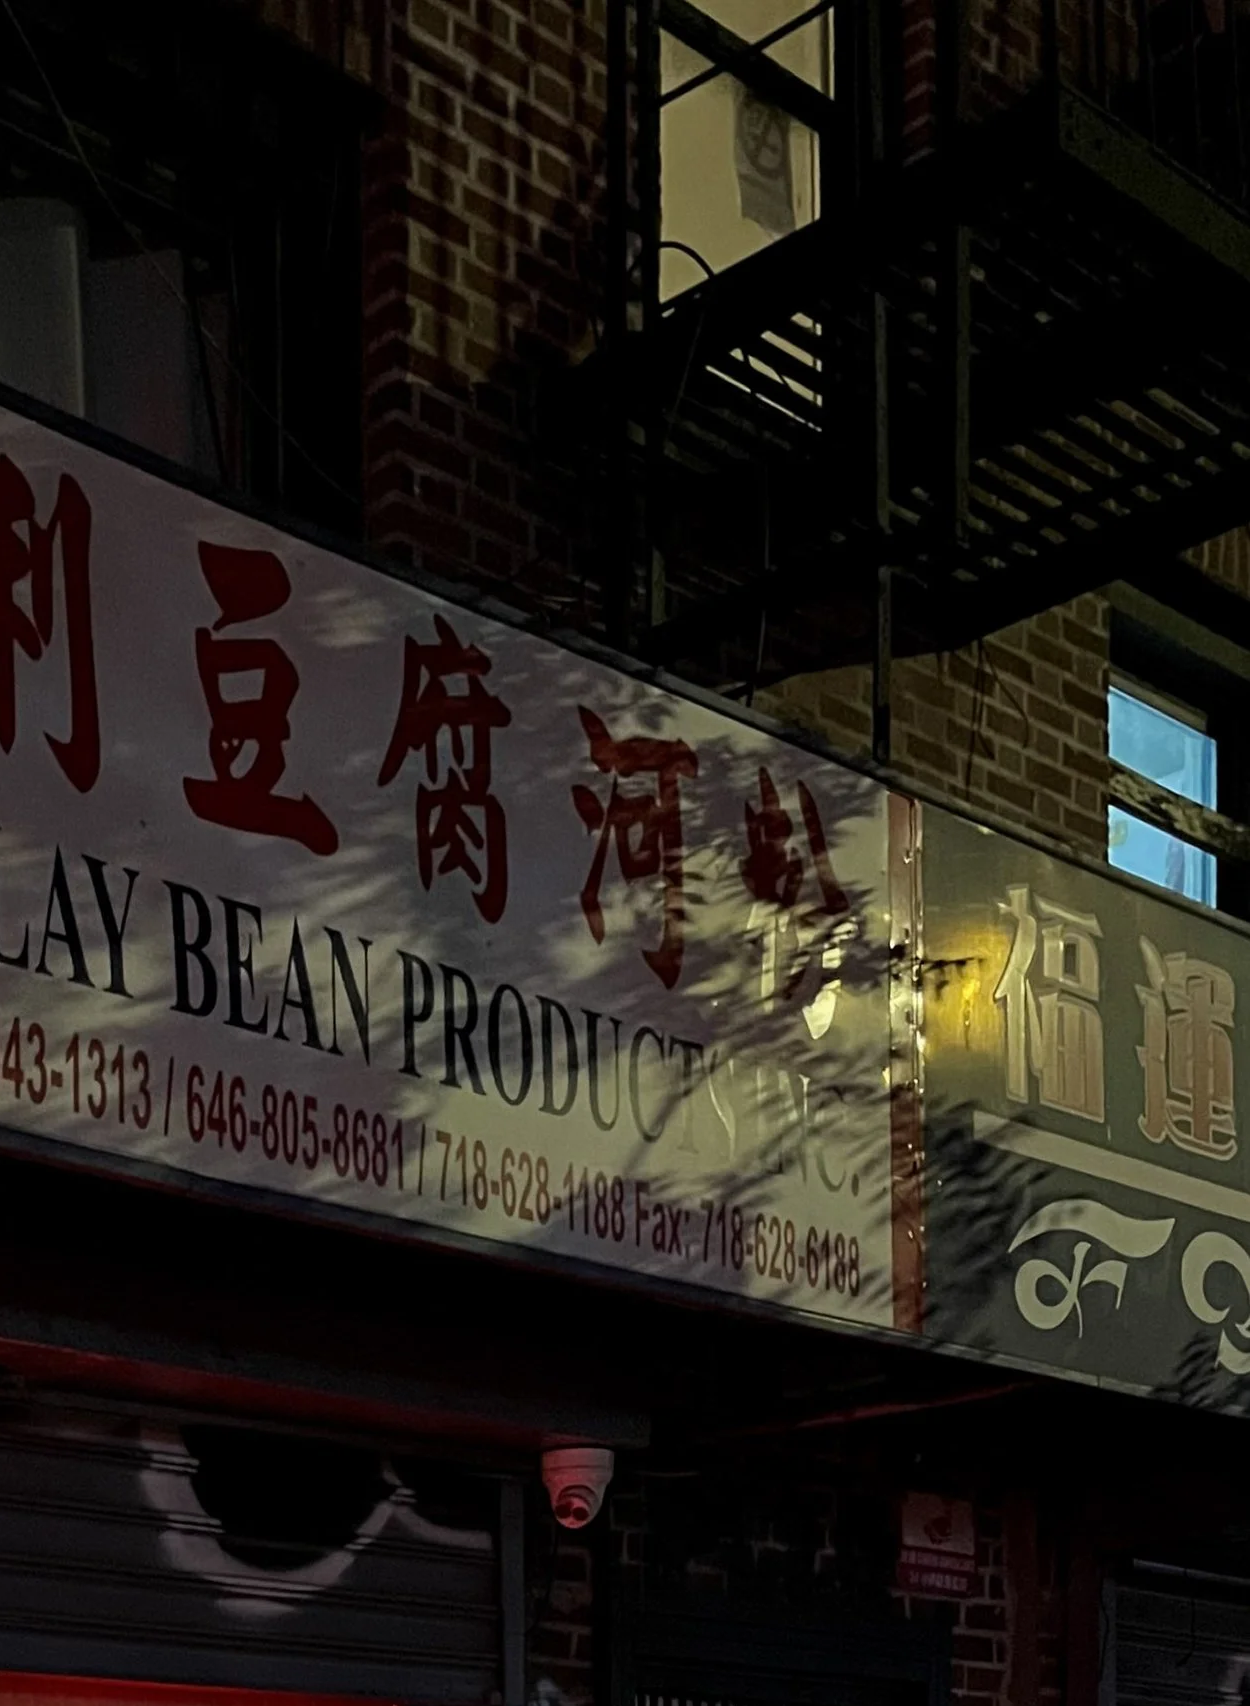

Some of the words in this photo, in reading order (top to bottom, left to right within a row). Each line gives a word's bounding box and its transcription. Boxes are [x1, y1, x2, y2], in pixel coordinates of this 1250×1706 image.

[161, 879, 375, 1068] BEAN
[186, 1064, 405, 1191] 646-805-8681
[435, 1129, 626, 1243] 718-628-1188
[701, 1199, 860, 1298] 718-628-6188
